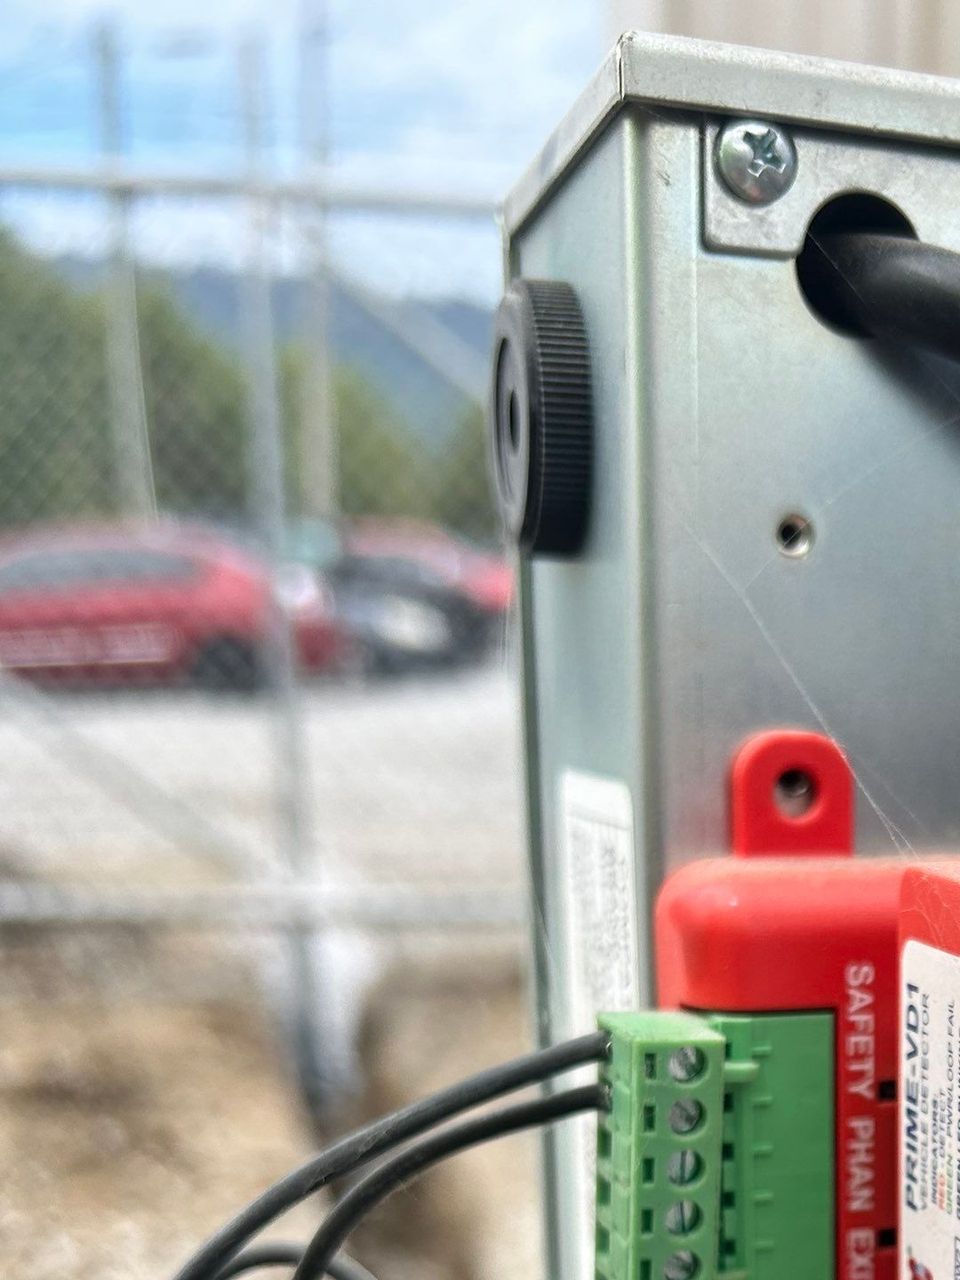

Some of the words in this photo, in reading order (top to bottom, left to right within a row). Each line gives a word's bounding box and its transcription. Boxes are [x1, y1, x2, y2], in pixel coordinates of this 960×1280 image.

[844, 962, 876, 1100] SAFETY
[920, 993, 929, 1114] DETECTOR
[905, 982, 919, 1211] PRIME-VD1
[848, 1116, 876, 1214] PHAN
[919, 1120, 927, 1212] VEHICLE
